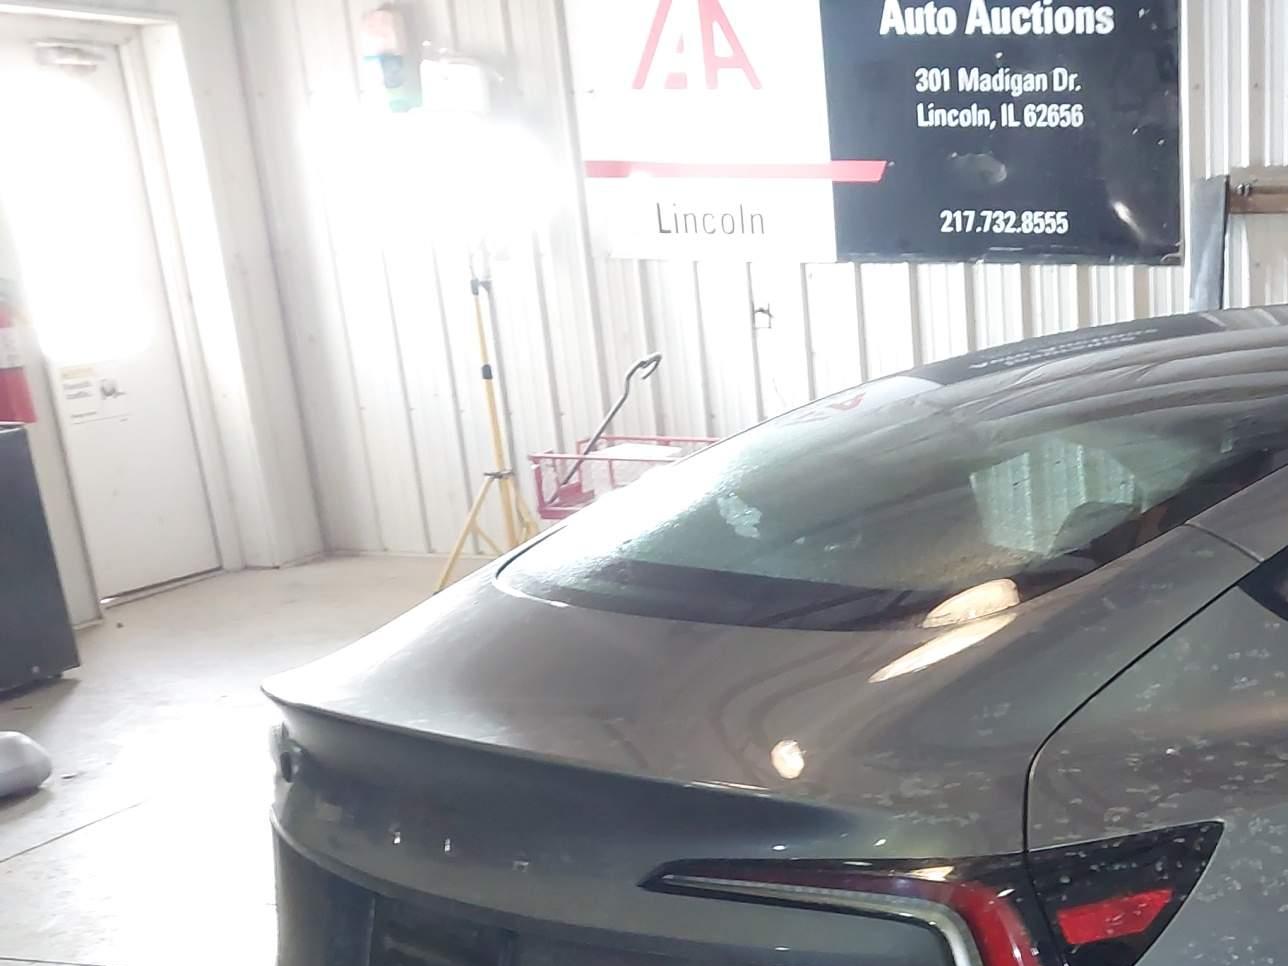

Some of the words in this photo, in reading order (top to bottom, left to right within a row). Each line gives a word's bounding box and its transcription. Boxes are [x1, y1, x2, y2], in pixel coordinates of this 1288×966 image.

[880, 0, 957, 36] Auto
[964, 0, 1115, 36] Auctions
[914, 67, 951, 92] 301
[957, 67, 1048, 97] Madigan
[1052, 67, 1082, 92] Dr.
[916, 102, 997, 130] Lincoln,
[1000, 102, 1021, 127] IL
[1023, 103, 1084, 128] 62656
[656, 202, 765, 235] Lincoln
[939, 209, 1069, 234] 217.732.8555
